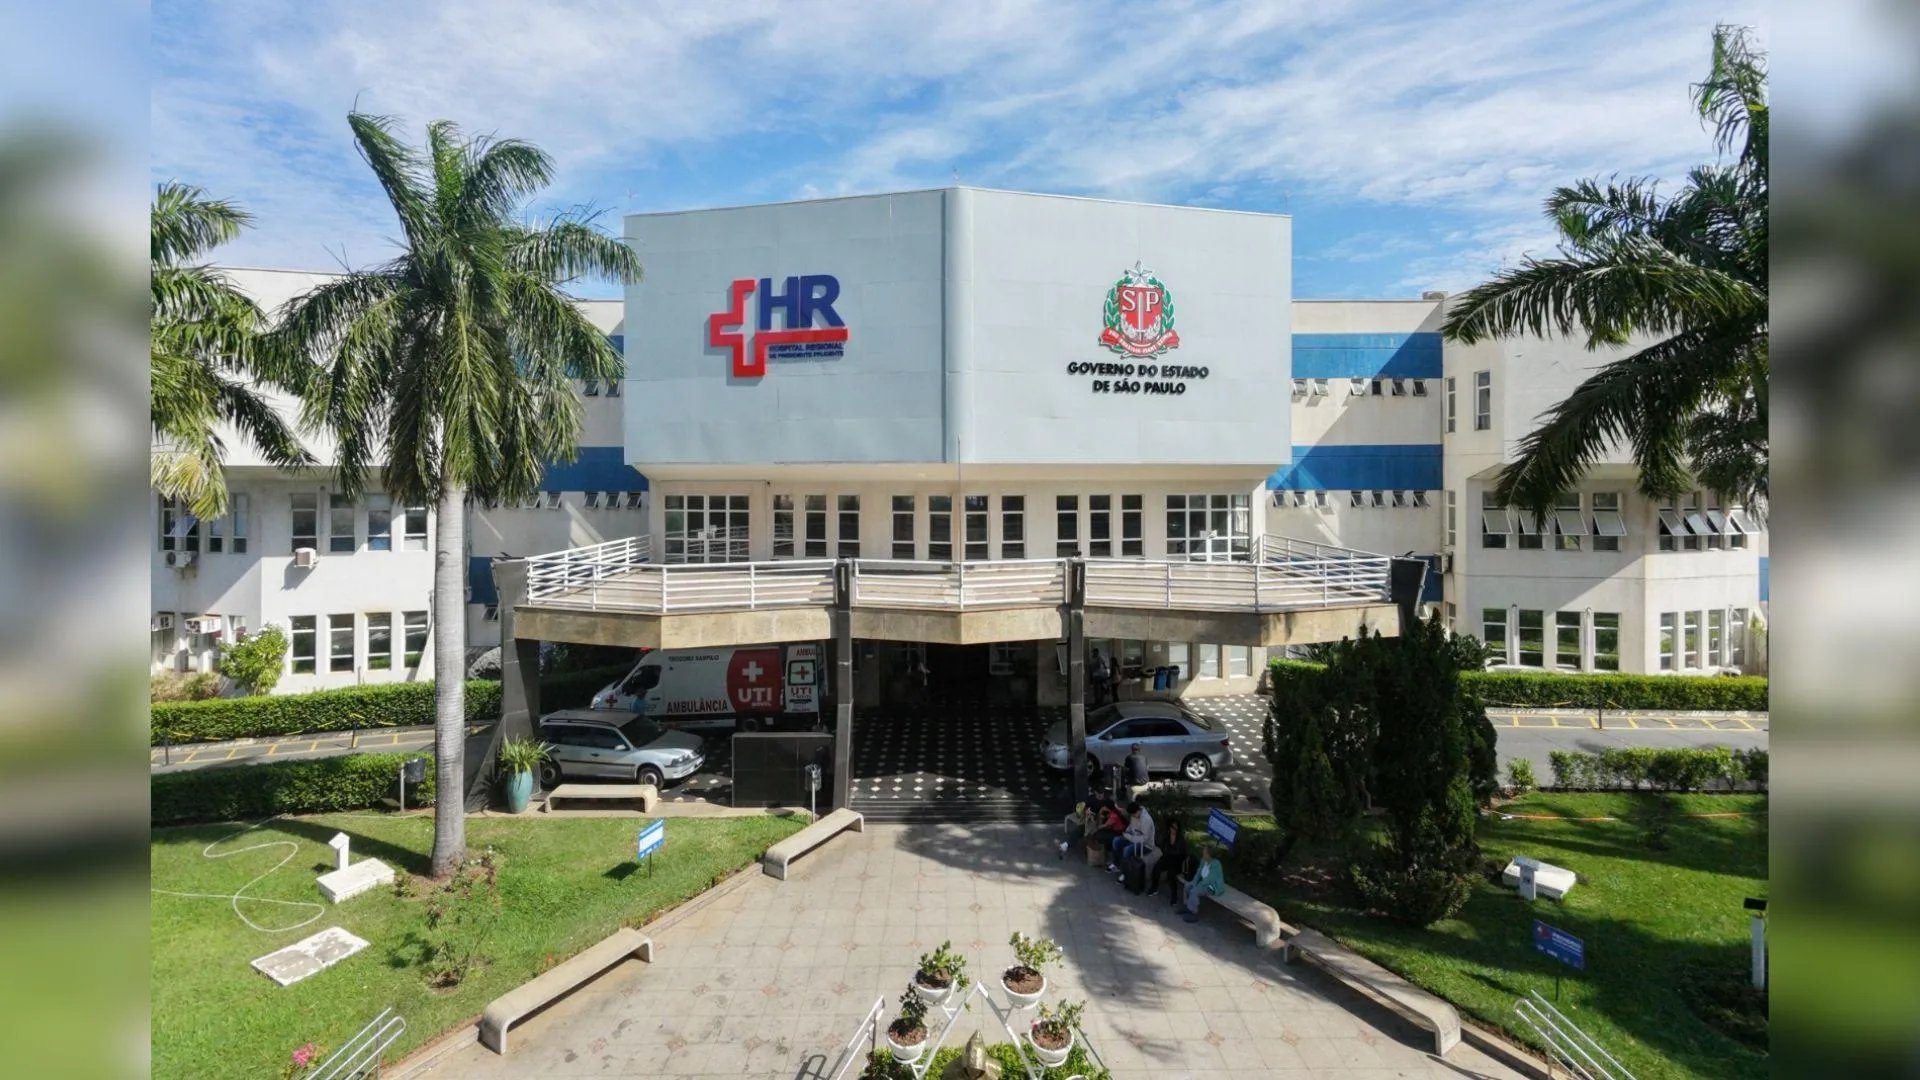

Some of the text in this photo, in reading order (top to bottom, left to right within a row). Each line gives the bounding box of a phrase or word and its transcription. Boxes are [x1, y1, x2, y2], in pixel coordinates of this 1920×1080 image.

[760, 275, 845, 330] HR
[1068, 362, 1210, 379] GOVERNO DO ESTADO
[1093, 378, 1186, 394] DE SÃO PAULO
[738, 688, 772, 702] UTI
[791, 687, 812, 695] UTI
[666, 697, 728, 713] AMBULÂNCIA
